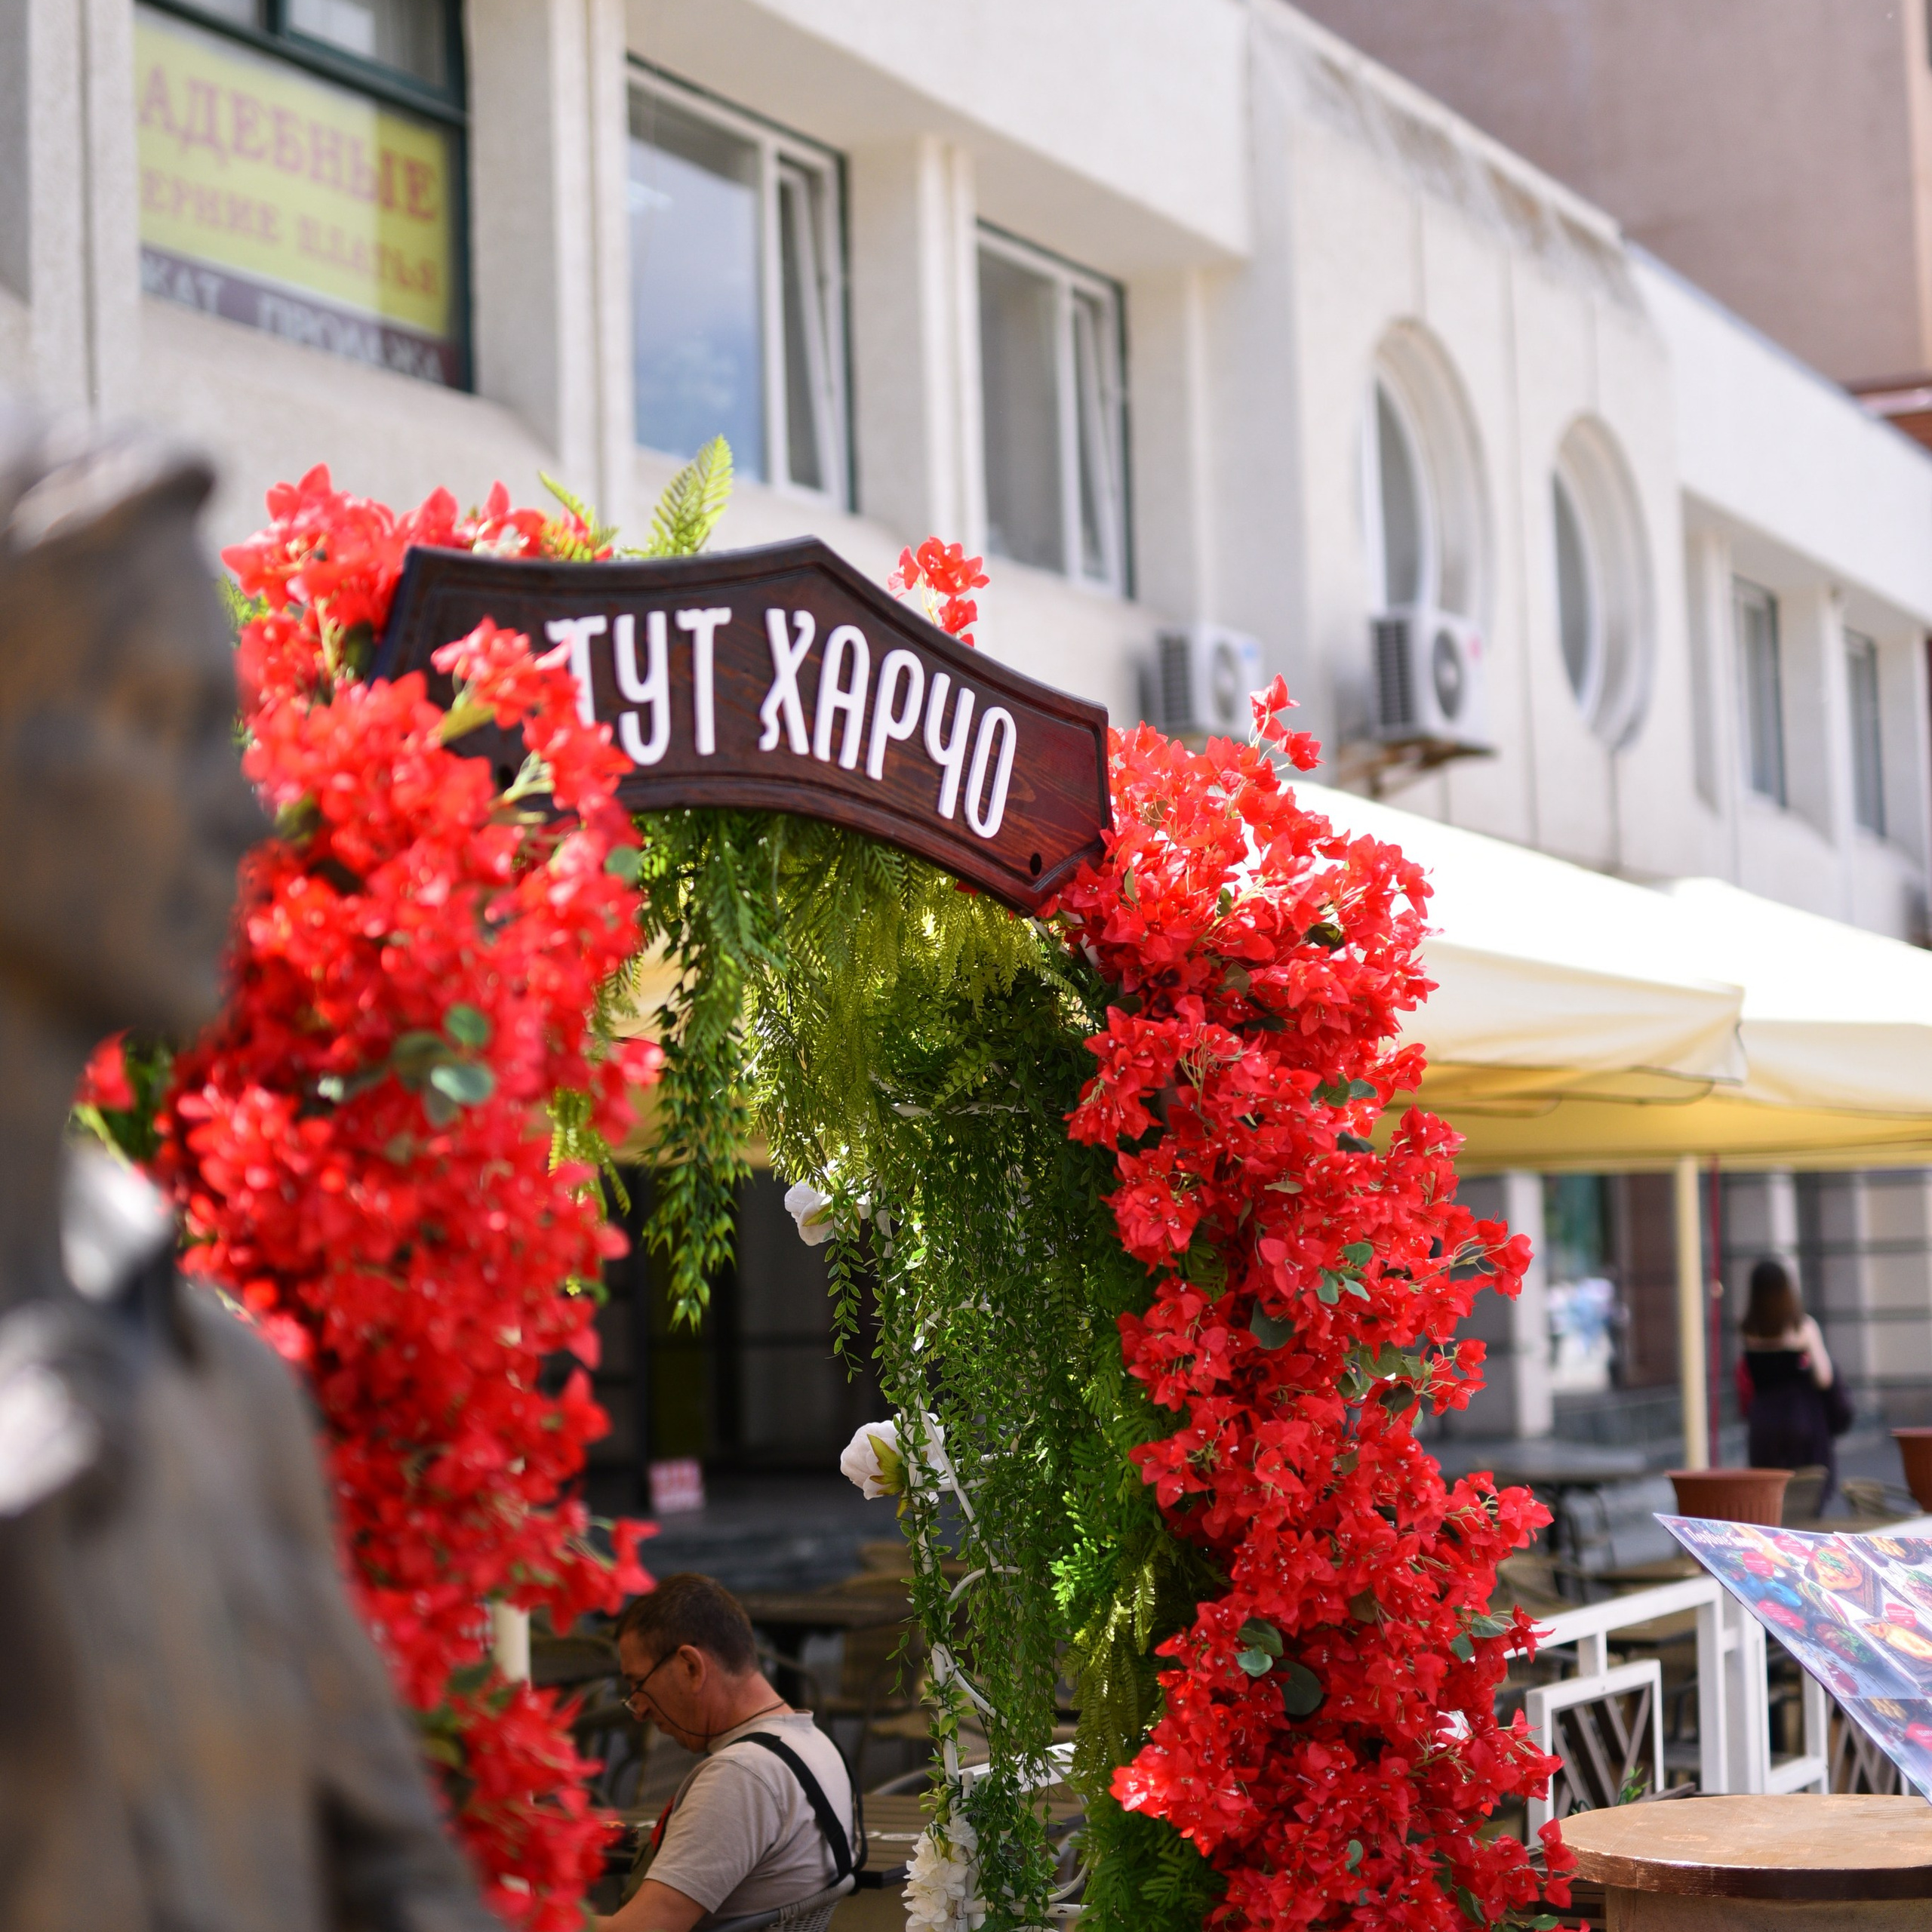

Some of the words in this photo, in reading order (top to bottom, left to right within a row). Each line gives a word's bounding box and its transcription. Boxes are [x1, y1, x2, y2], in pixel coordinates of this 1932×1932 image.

[140, 65, 437, 221] АДЕБНЫЕ
[546, 607, 732, 765] ТУТ
[758, 608, 1017, 838] ХАРЧО
